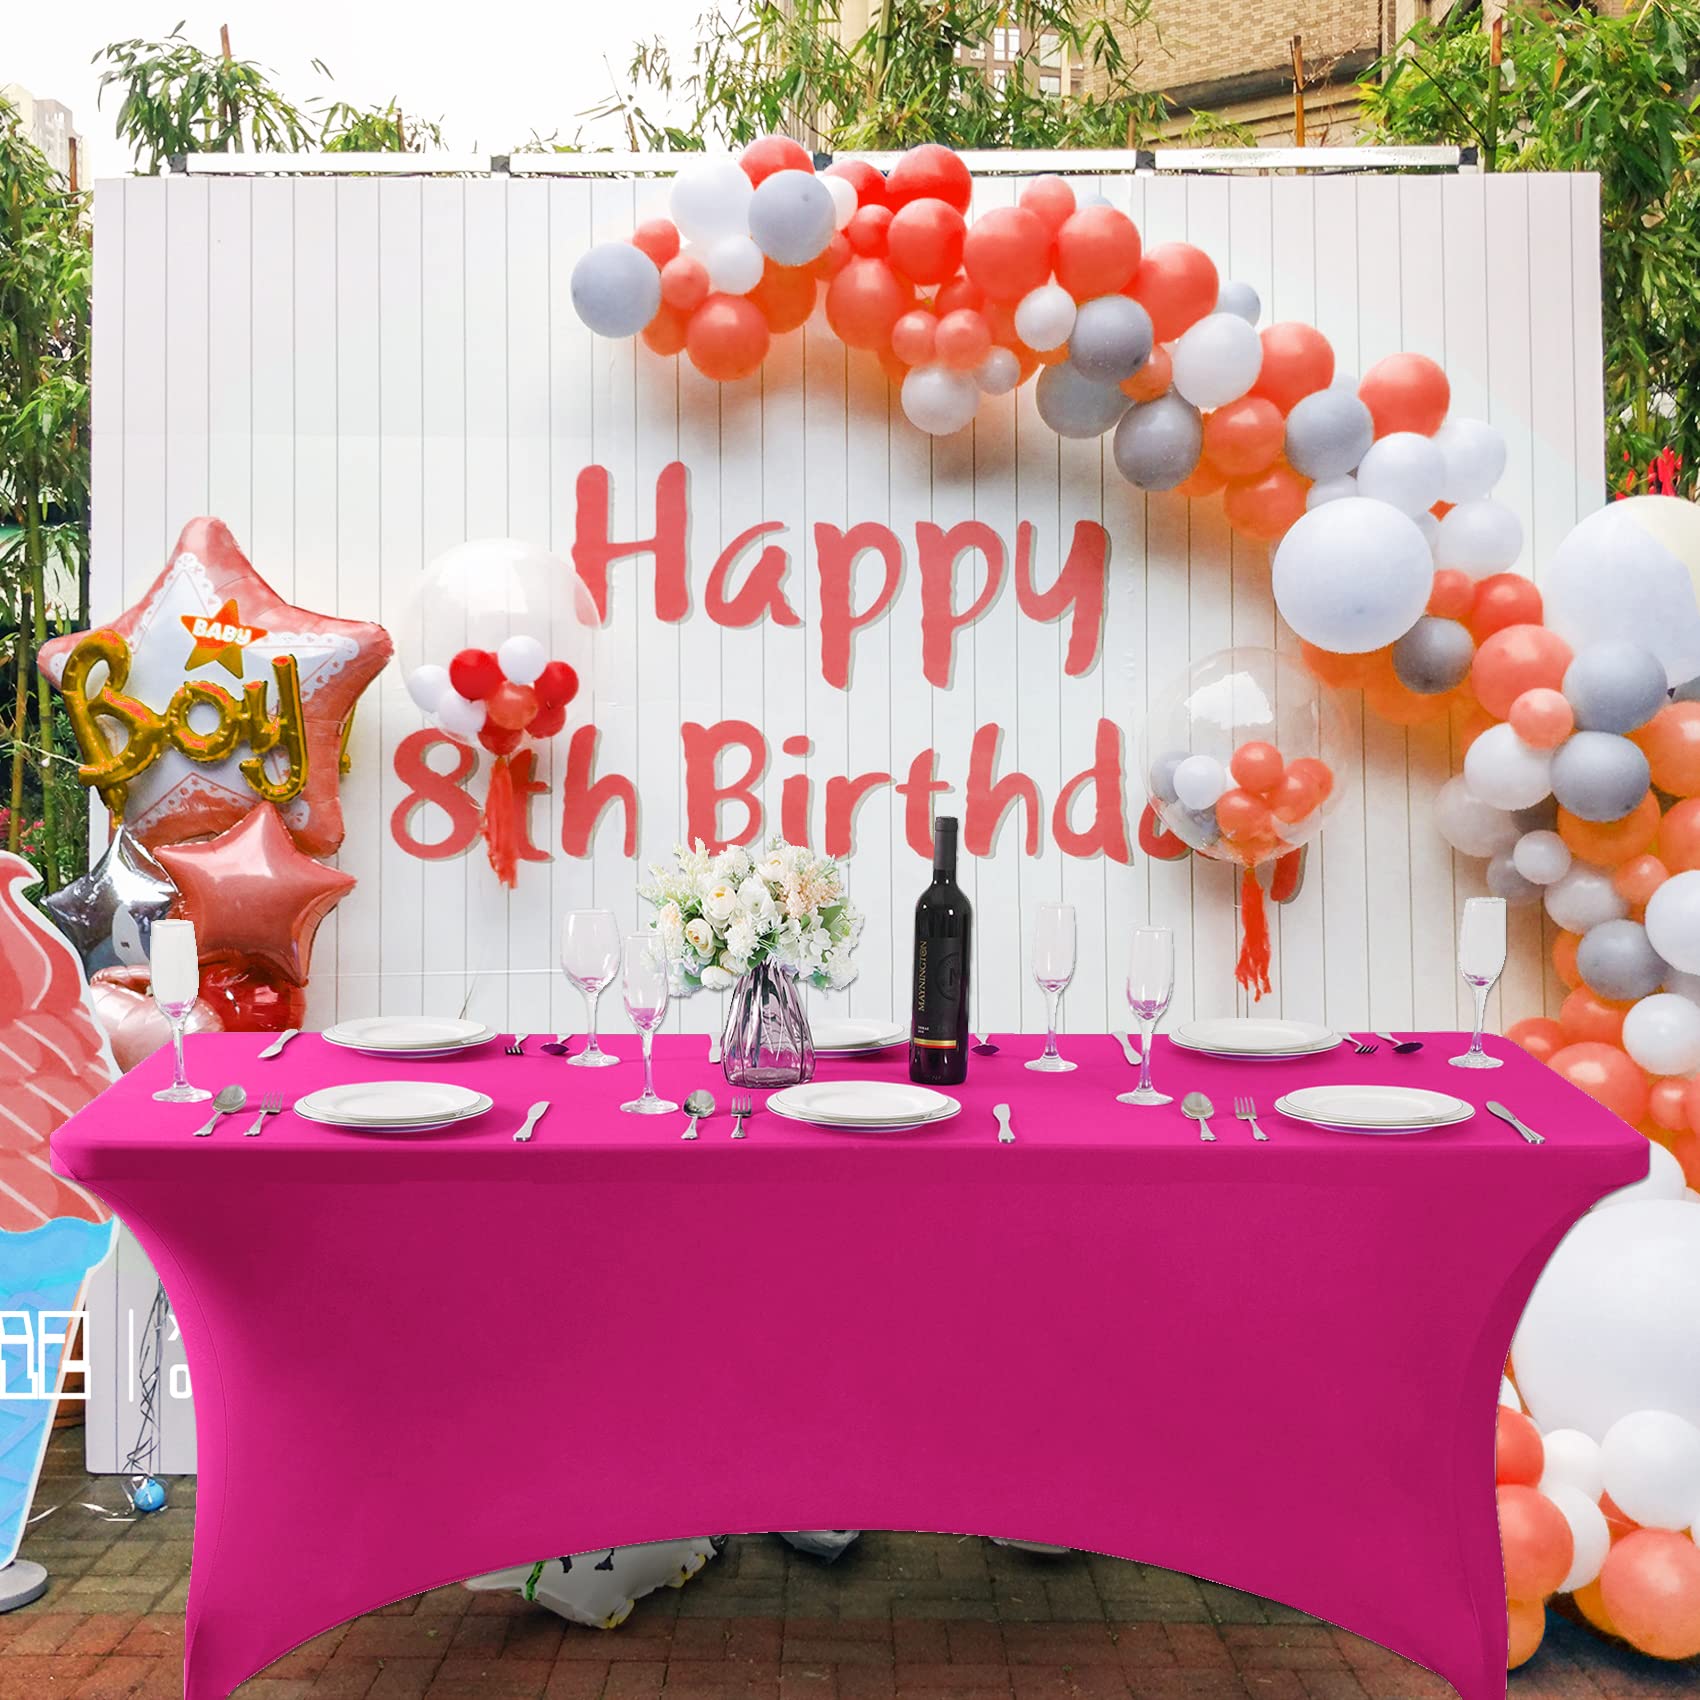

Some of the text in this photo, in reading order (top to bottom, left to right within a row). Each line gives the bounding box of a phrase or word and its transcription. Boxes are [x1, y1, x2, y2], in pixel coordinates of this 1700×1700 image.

[193, 619, 252, 646] BABY
[572, 461, 1107, 689] Happy
[61, 629, 309, 803] Boy
[391, 724, 637, 861] 8th
[918, 940, 928, 1012] MAYNINGTON
